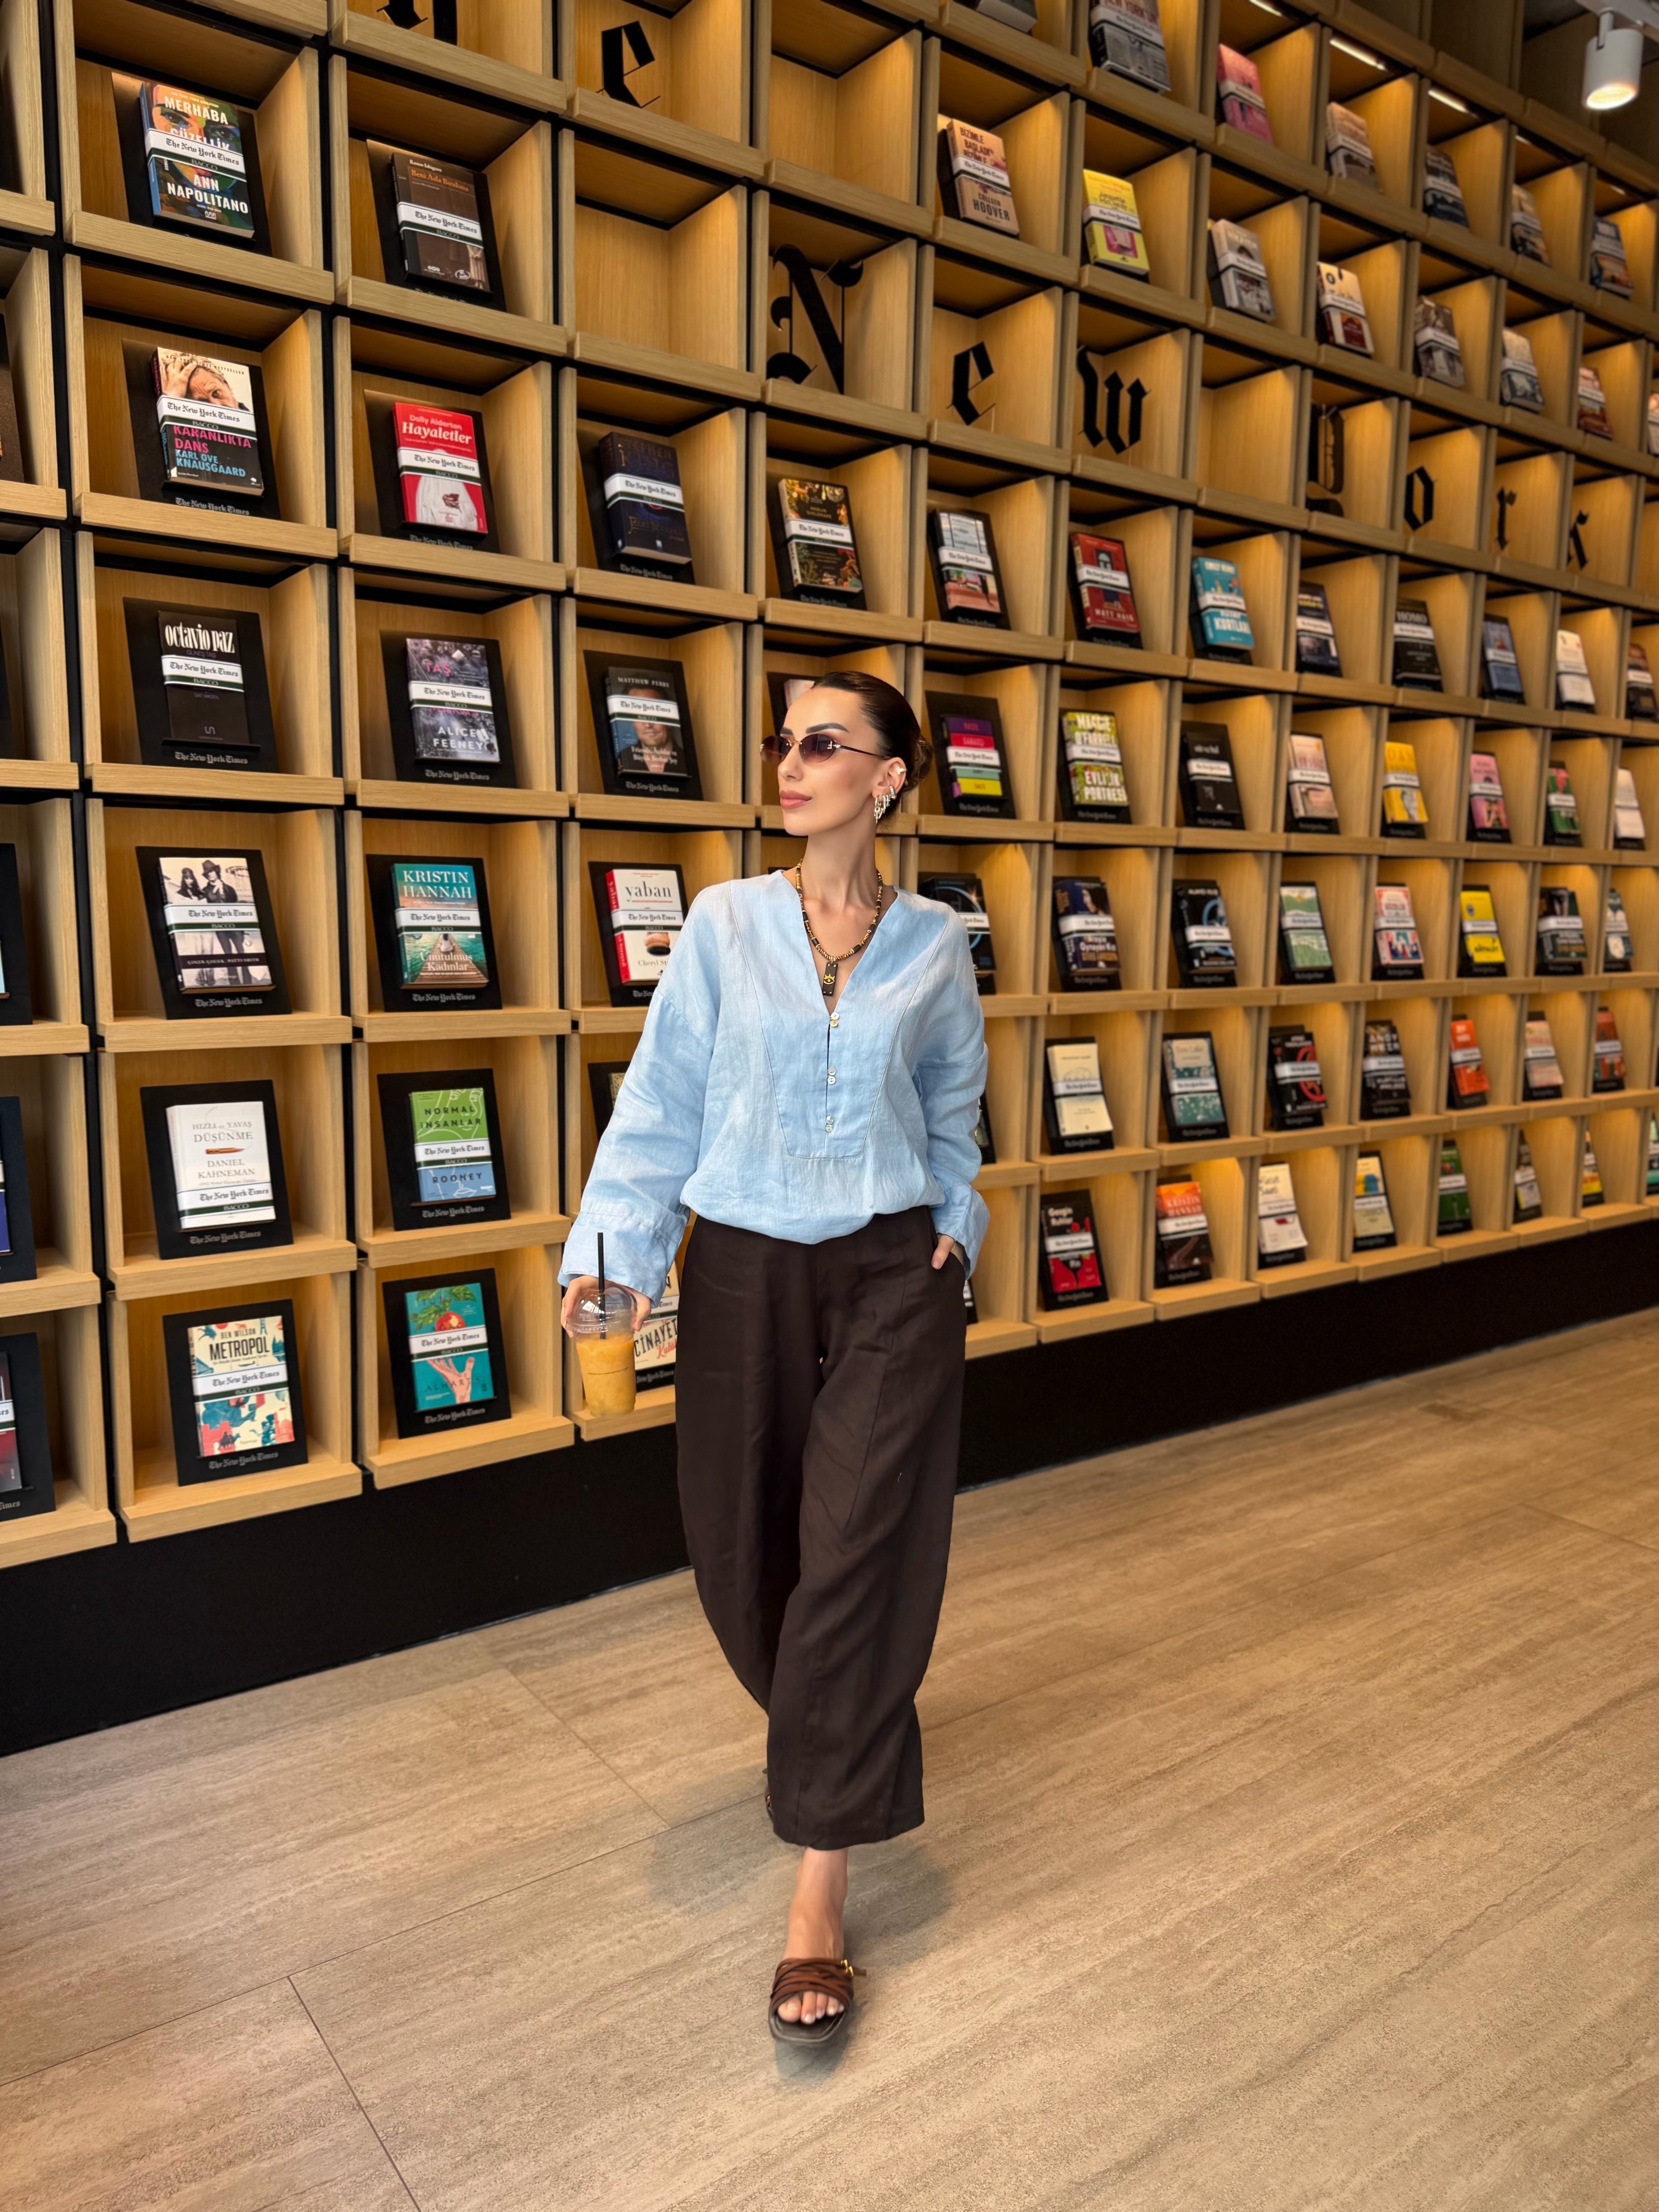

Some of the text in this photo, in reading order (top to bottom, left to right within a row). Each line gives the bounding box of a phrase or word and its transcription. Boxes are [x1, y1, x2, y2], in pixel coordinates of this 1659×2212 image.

[165, 96, 228, 125] MERHABA
[166, 138, 239, 165] The New York Times
[192, 159, 217, 170] BACCO
[194, 174, 219, 192] ANN
[411, 169, 426, 179] Beni
[428, 174, 441, 184] Asla
[167, 182, 248, 213] NAPOLITANO
[978, 193, 1001, 206] COLLEEN
[972, 199, 1010, 221] HOOVER
[415, 211, 477, 234] The New York Times
[167, 402, 240, 422] The New York Times
[193, 421, 218, 430] BACCO
[409, 415, 462, 430] Dolly Alderton
[172, 425, 252, 448] KARANLIKTA
[402, 421, 472, 444] Hayaletler
[174, 438, 209, 454] DANS
[175, 449, 218, 464] KARL OVE
[414, 454, 476, 471] The New York Times
[176, 458, 246, 477] KNAUSGAARD
[647, 485, 660, 493] York
[661, 488, 676, 497] Times
[1095, 608, 1114, 617] MATT
[165, 622, 235, 653] octavio paz
[170, 662, 239, 677] The New York Times
[425, 662, 451, 681] TAŞ
[467, 692, 485, 700] Times
[656, 705, 671, 713] Times
[438, 726, 476, 738] ALICE
[433, 738, 483, 749] FEENEY
[175, 751, 248, 764] The New York Times
[403, 871, 469, 883] KRISTIN
[403, 885, 472, 898] HANNAH
[625, 881, 672, 902] yaban
[217, 910, 233, 918] York
[437, 914, 452, 922] York
[421, 952, 472, 963] Unutulmuş
[427, 962, 469, 971] Kadınlar
[424, 1106, 474, 1115] NORMAL
[227, 1121, 252, 1130] YAVAŞ
[194, 1132, 253, 1144] DÜŞÜNME
[451, 1146, 465, 1154] York
[207, 1158, 245, 1168] DANIEL
[198, 1168, 256, 1179] KAHNEMAN
[432, 1172, 482, 1184] ROONEY
[230, 1190, 247, 1199] York
[221, 1328, 256, 1339] BEN WILSON
[447, 1336, 461, 1344] York
[634, 1317, 678, 1357] CİNAYET
[210, 1336, 270, 1361] METROPOL
[226, 1377, 240, 1385] New
[242, 1374, 259, 1384] York
[259, 1371, 280, 1380] Times
